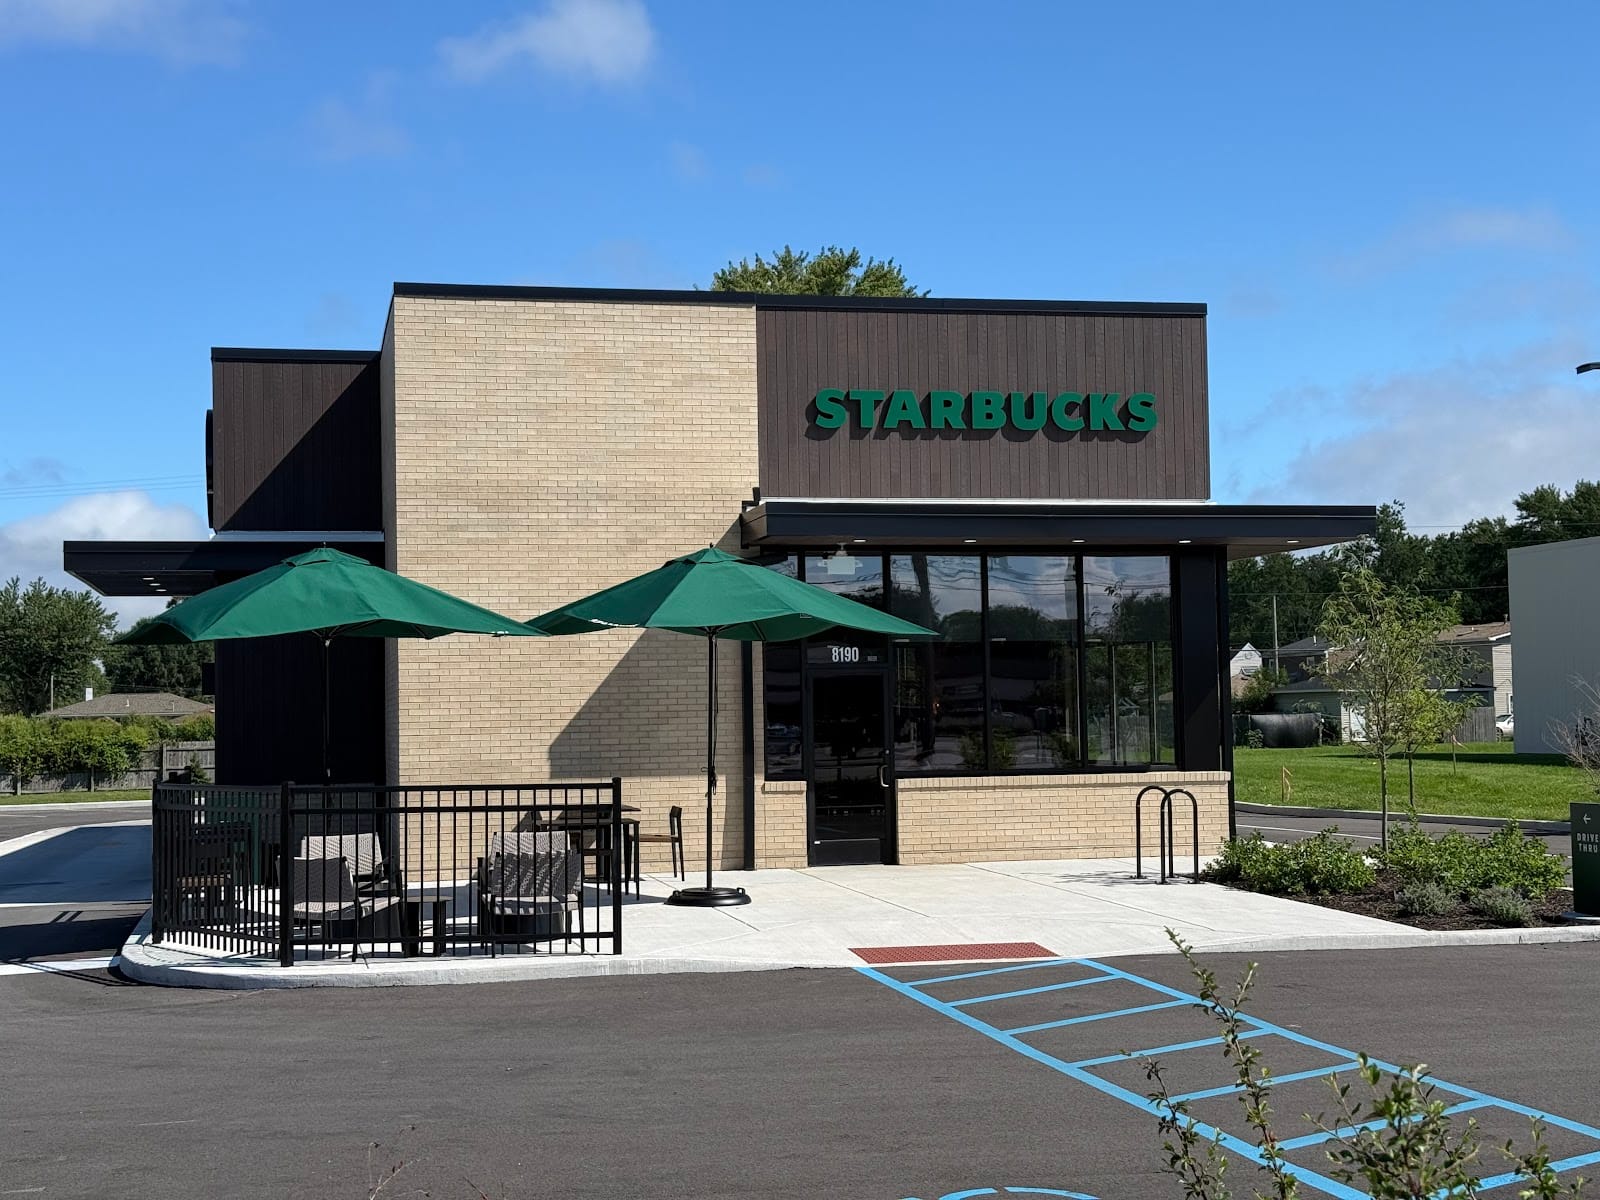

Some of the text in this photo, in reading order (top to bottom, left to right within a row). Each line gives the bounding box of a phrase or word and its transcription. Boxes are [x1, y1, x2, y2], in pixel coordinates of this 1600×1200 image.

[815, 388, 1157, 431] STARBUCKS
[832, 647, 859, 662] 8190
[1576, 833, 1599, 842] DRIVE
[1578, 843, 1598, 853] THRU
